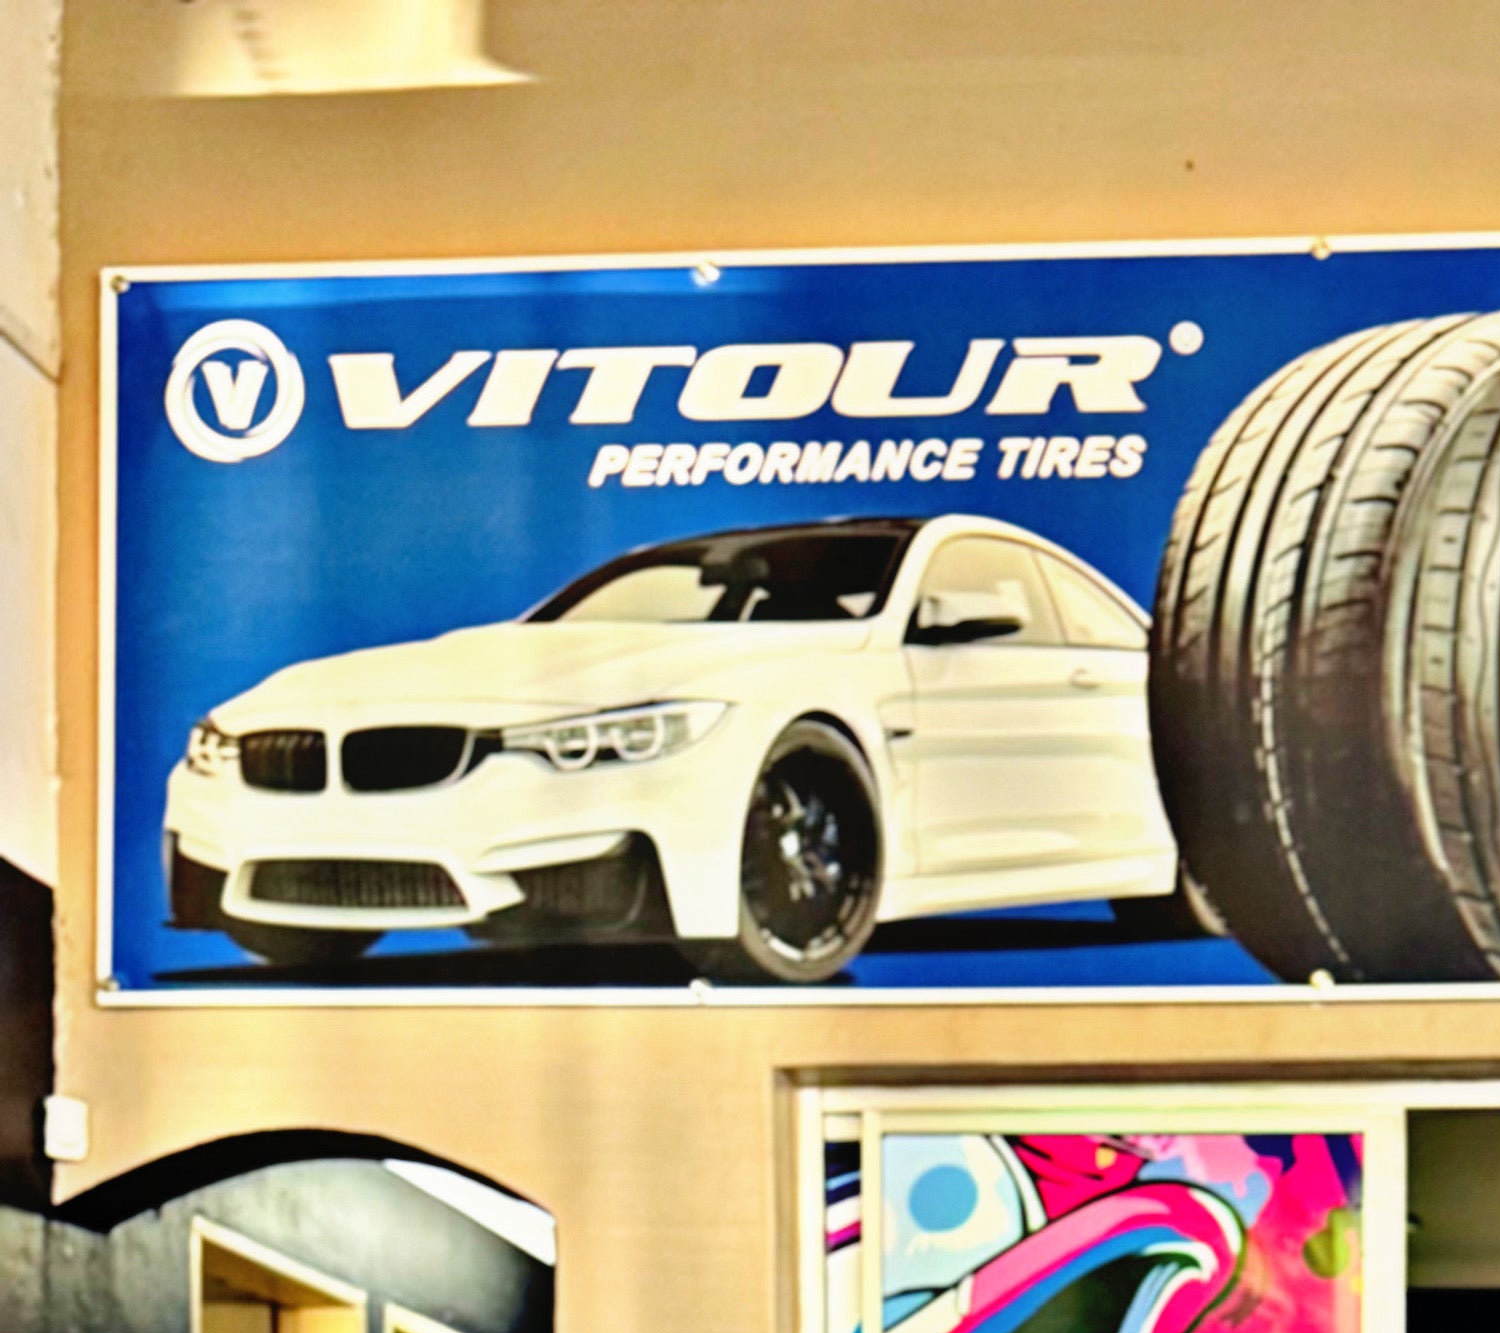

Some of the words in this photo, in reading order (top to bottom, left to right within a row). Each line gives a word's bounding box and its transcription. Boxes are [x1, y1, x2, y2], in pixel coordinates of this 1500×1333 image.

[328, 335, 1163, 430] VITOUR
[587, 438, 984, 488] PERFORMANCE
[998, 434, 1148, 480] TIRES
